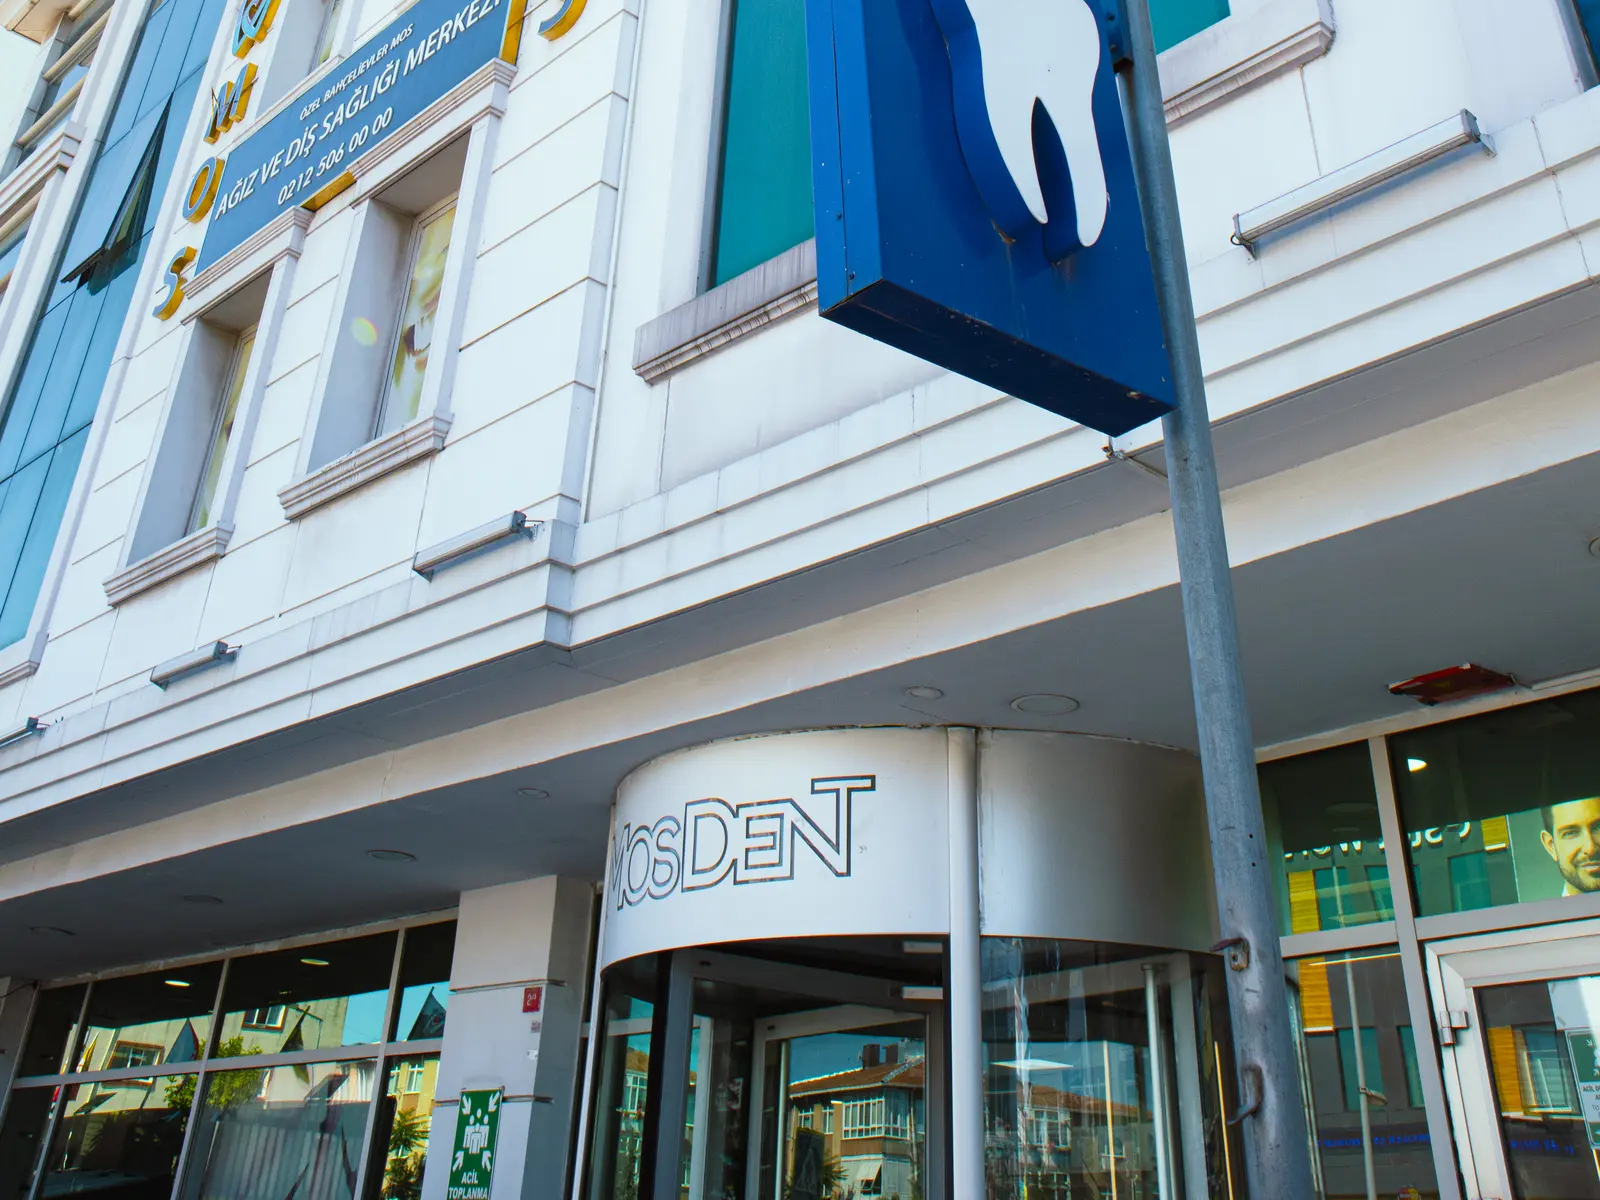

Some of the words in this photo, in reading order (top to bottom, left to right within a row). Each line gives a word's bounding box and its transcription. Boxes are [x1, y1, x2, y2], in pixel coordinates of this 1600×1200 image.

[299, 97, 321, 121] ÖZEL
[323, 43, 389, 102] BAHÇELİEVLER
[389, 23, 415, 50] MOS
[214, 168, 260, 220] AĞIZ
[260, 149, 285, 185] VE
[284, 123, 318, 167] DİŞ
[319, 59, 401, 140] SAĞLIĞI
[277, 166, 314, 205] 0212
[316, 143, 345, 177] 506
[348, 125, 369, 153] 00
[371, 106, 393, 135] 00
[611, 774, 876, 912] MOSDENT
[449, 1186, 488, 1200] TOPLANMA
[461, 1169, 478, 1184] ACİL
